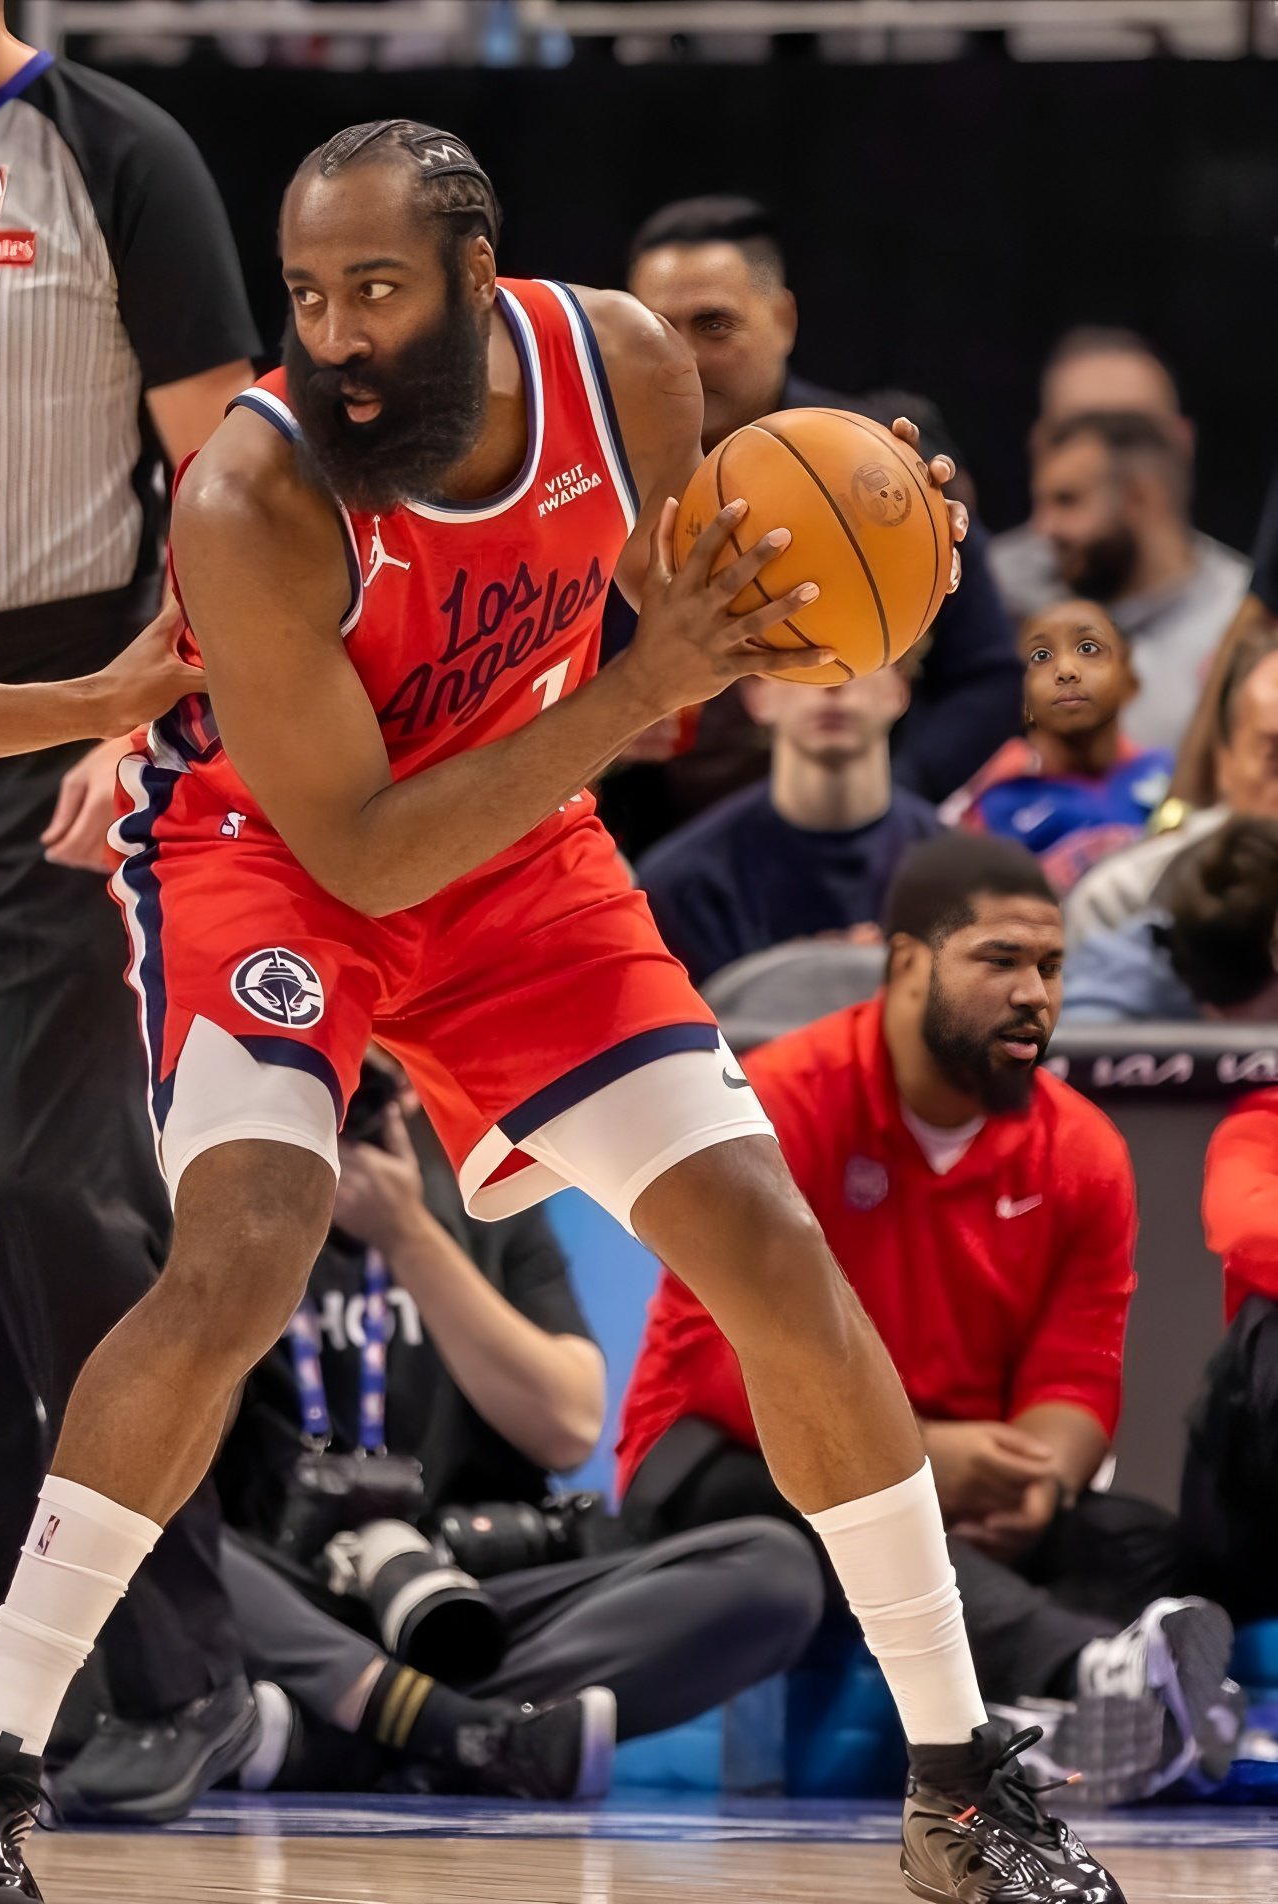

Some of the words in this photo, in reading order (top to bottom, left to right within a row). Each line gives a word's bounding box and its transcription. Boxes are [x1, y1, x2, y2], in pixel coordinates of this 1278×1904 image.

[537, 472, 603, 518] RWANDA
[544, 463, 583, 494] VISIT
[438, 560, 543, 666] Los
[377, 555, 607, 737] Angeles
[532, 656, 572, 712] 1
